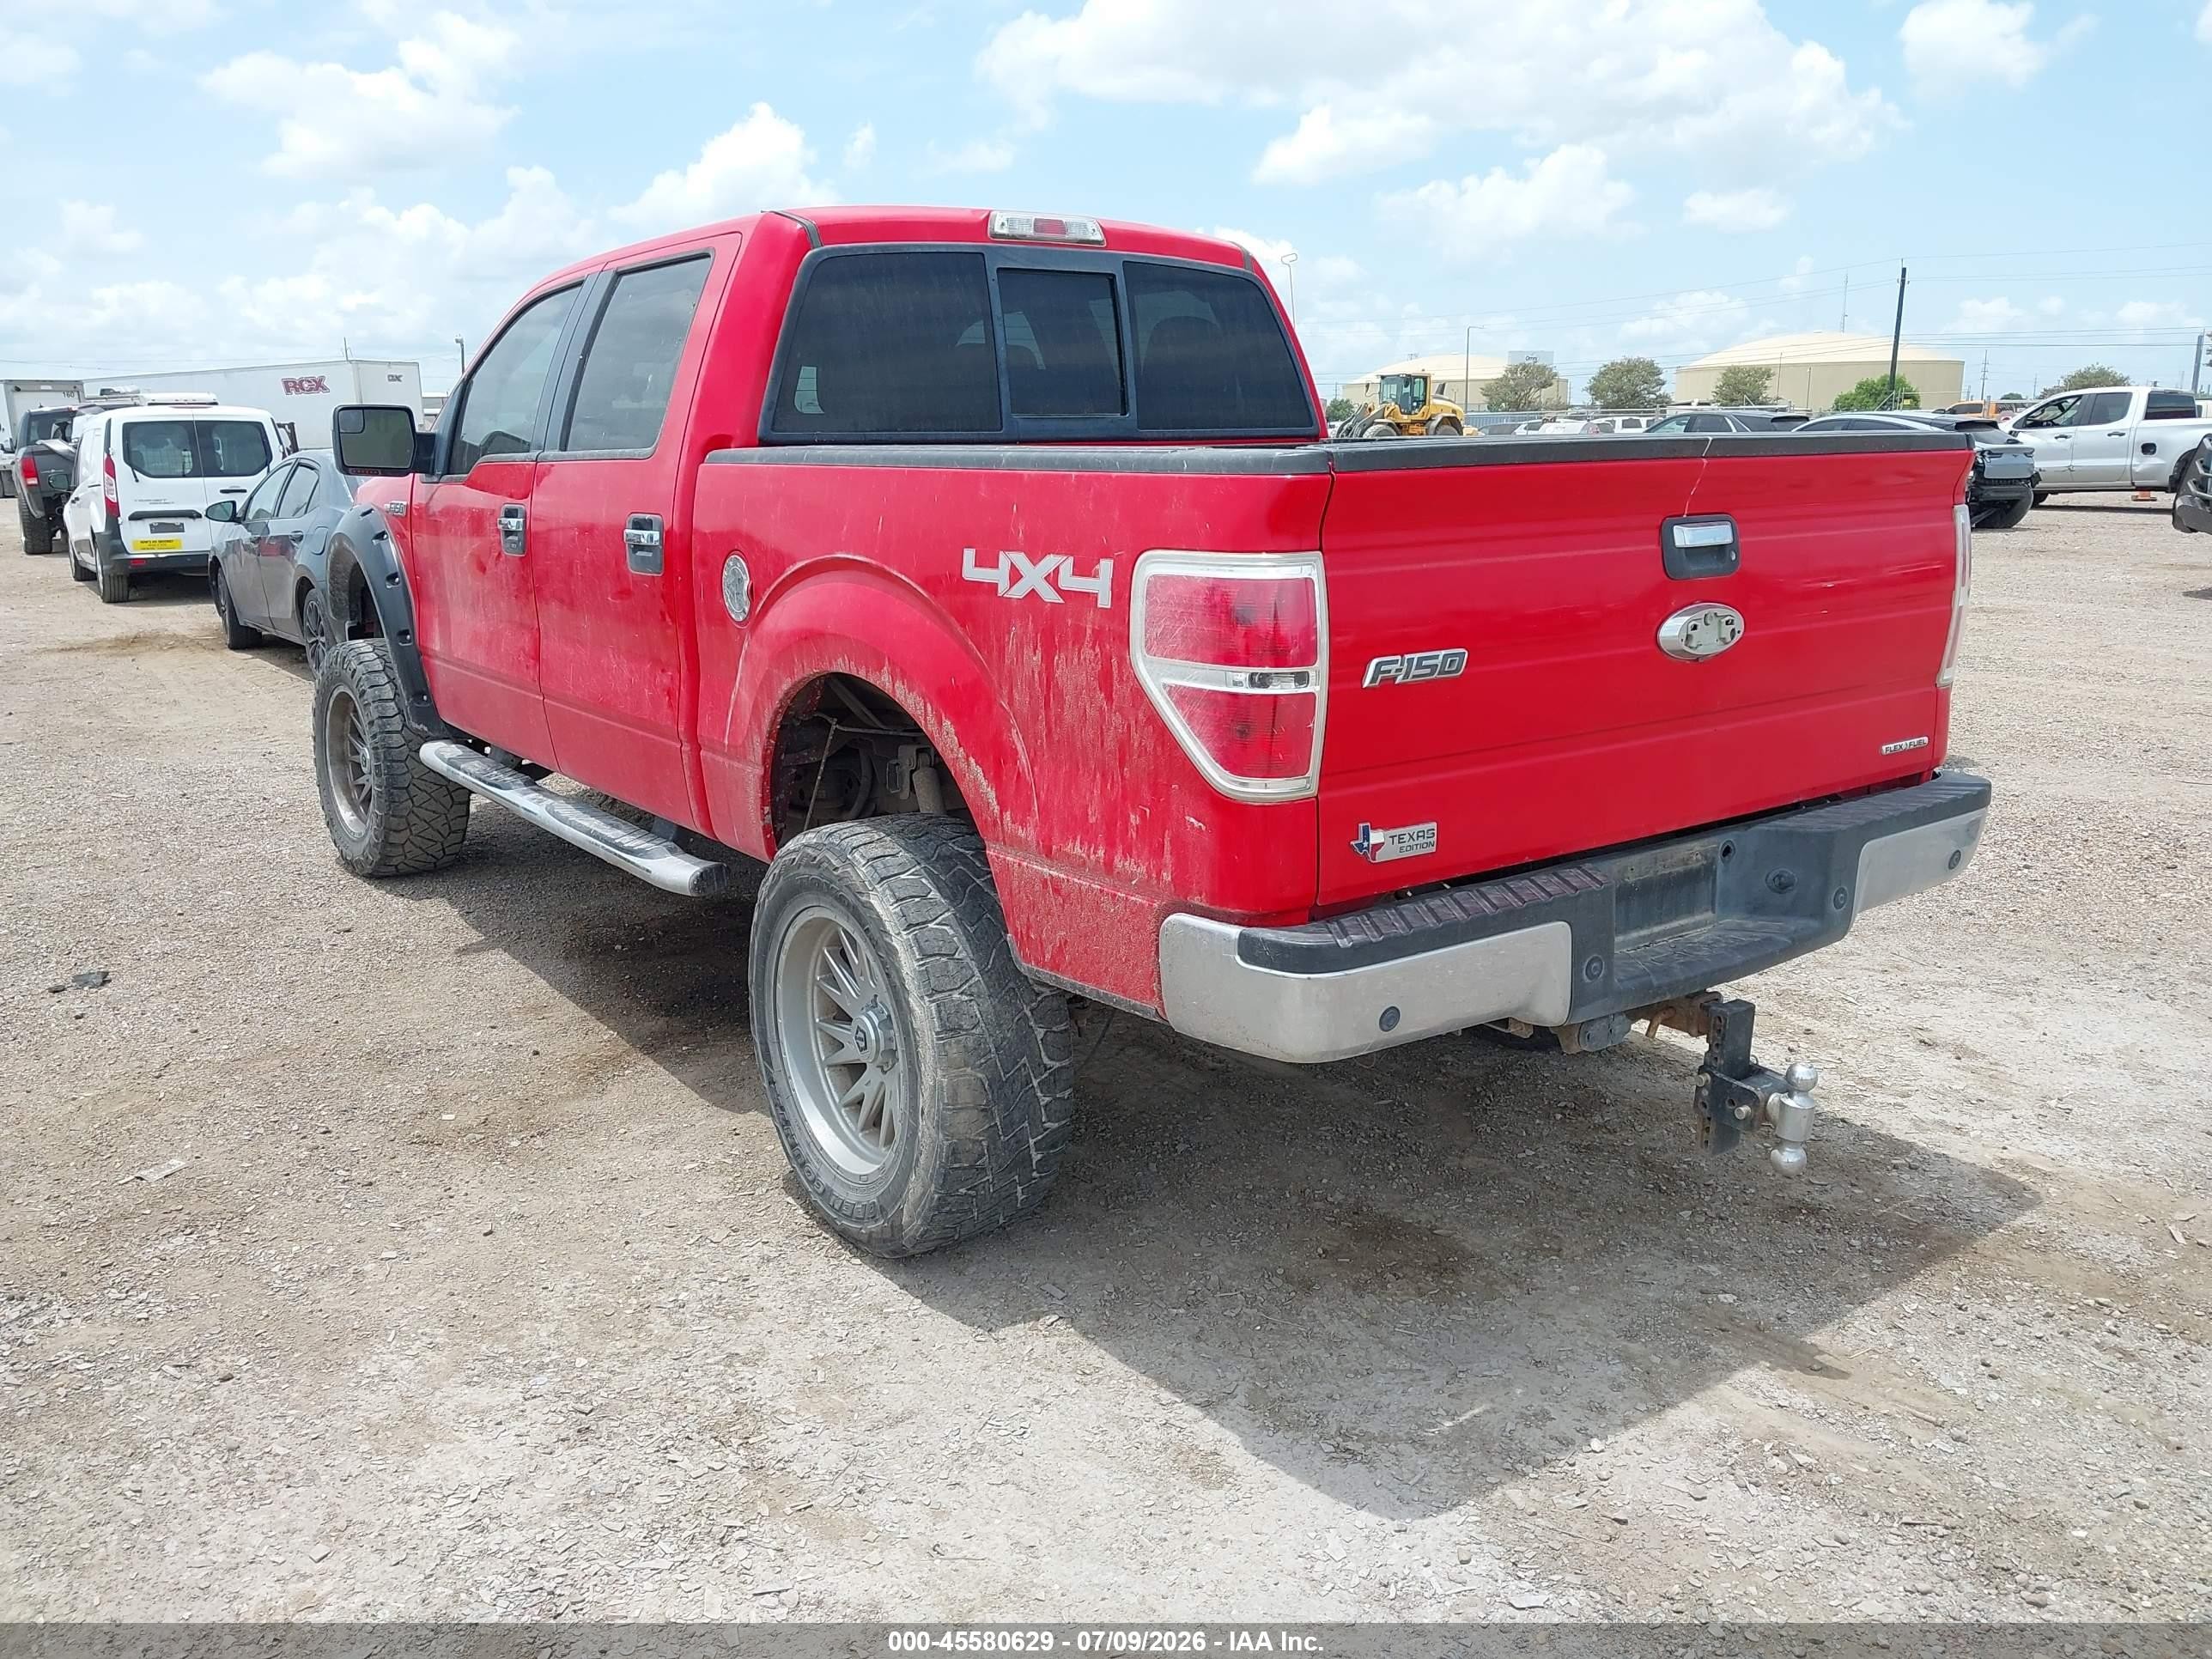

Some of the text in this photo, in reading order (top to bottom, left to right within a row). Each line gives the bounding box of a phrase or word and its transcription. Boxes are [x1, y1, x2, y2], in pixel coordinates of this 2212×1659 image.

[281, 375, 331, 395] RCX
[962, 547, 1114, 609] 4X4
[1389, 827, 1437, 846] TEXAS
[1399, 840, 1436, 854] EDITION
